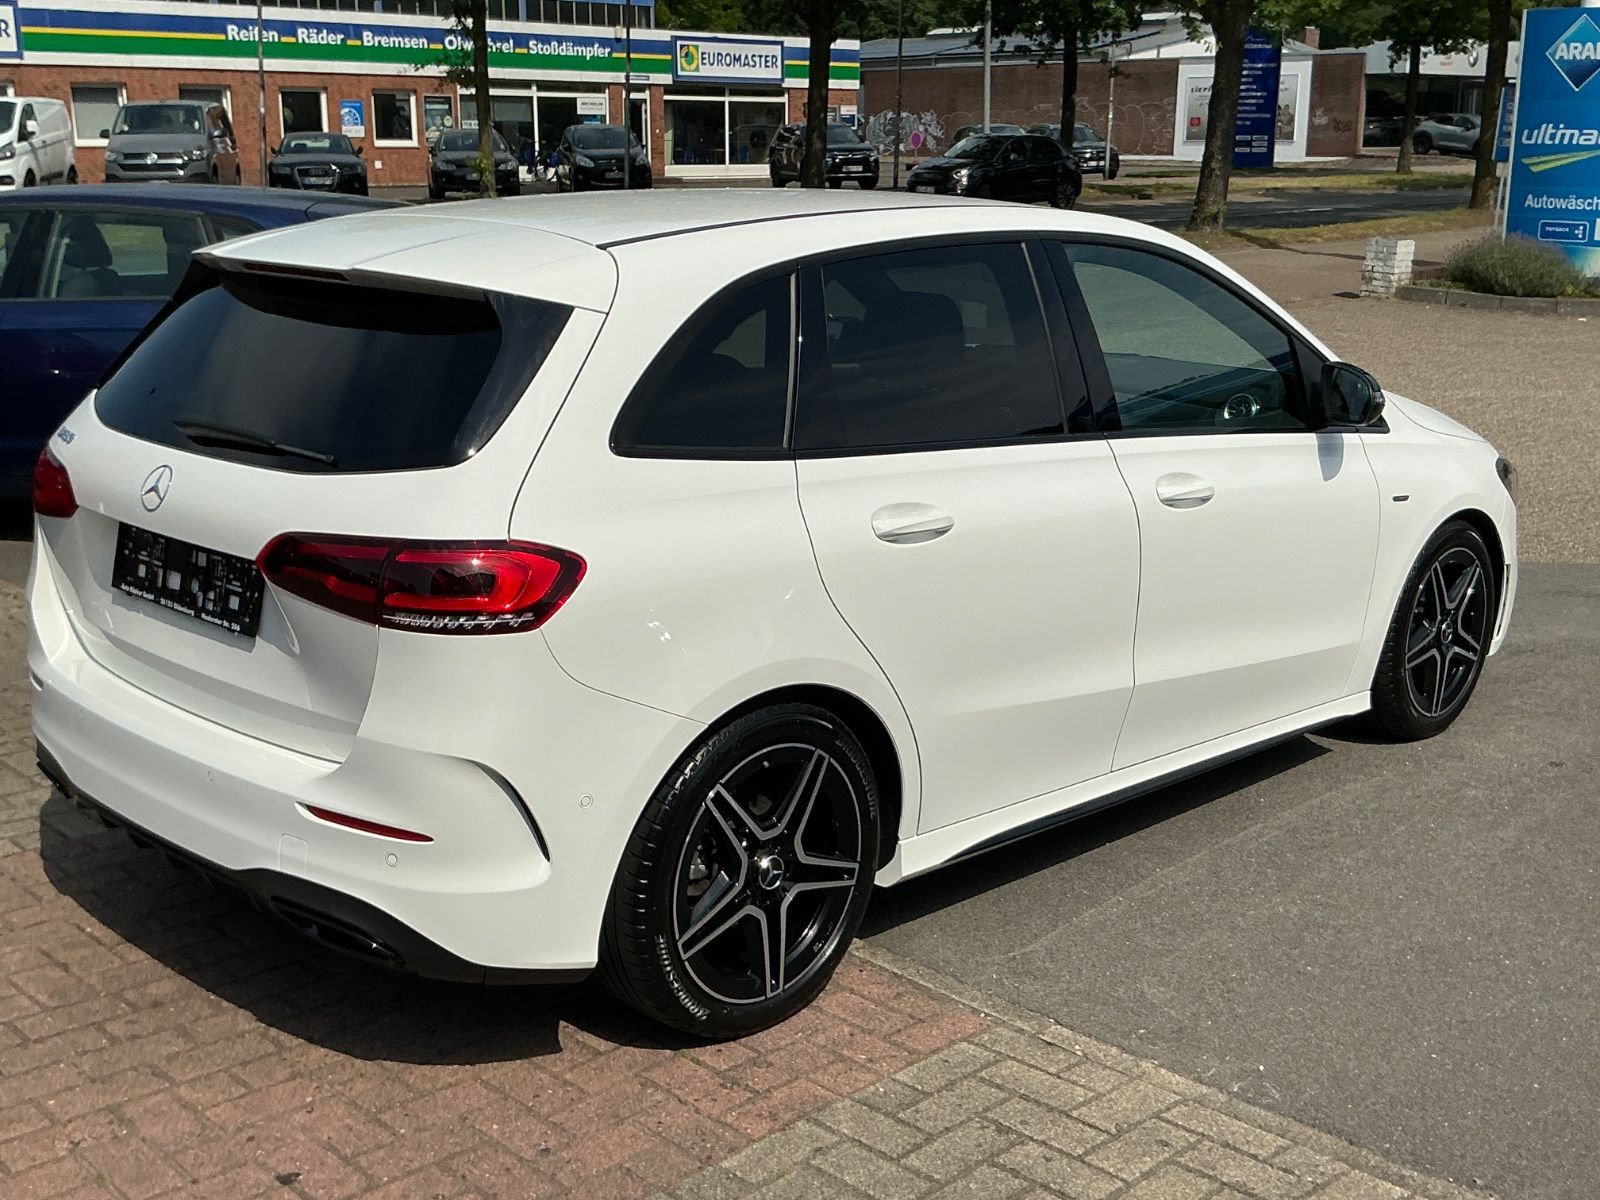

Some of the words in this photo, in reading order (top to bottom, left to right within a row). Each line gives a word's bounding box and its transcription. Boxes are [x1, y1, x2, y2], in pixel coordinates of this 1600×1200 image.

[226, 23, 279, 43] Reifen
[297, 27, 345, 45] Räder
[362, 31, 428, 49] Bremsen
[528, 40, 611, 61] Stoßdämpfer
[700, 51, 779, 69] EUROMASTER
[1521, 122, 1600, 145] ultima
